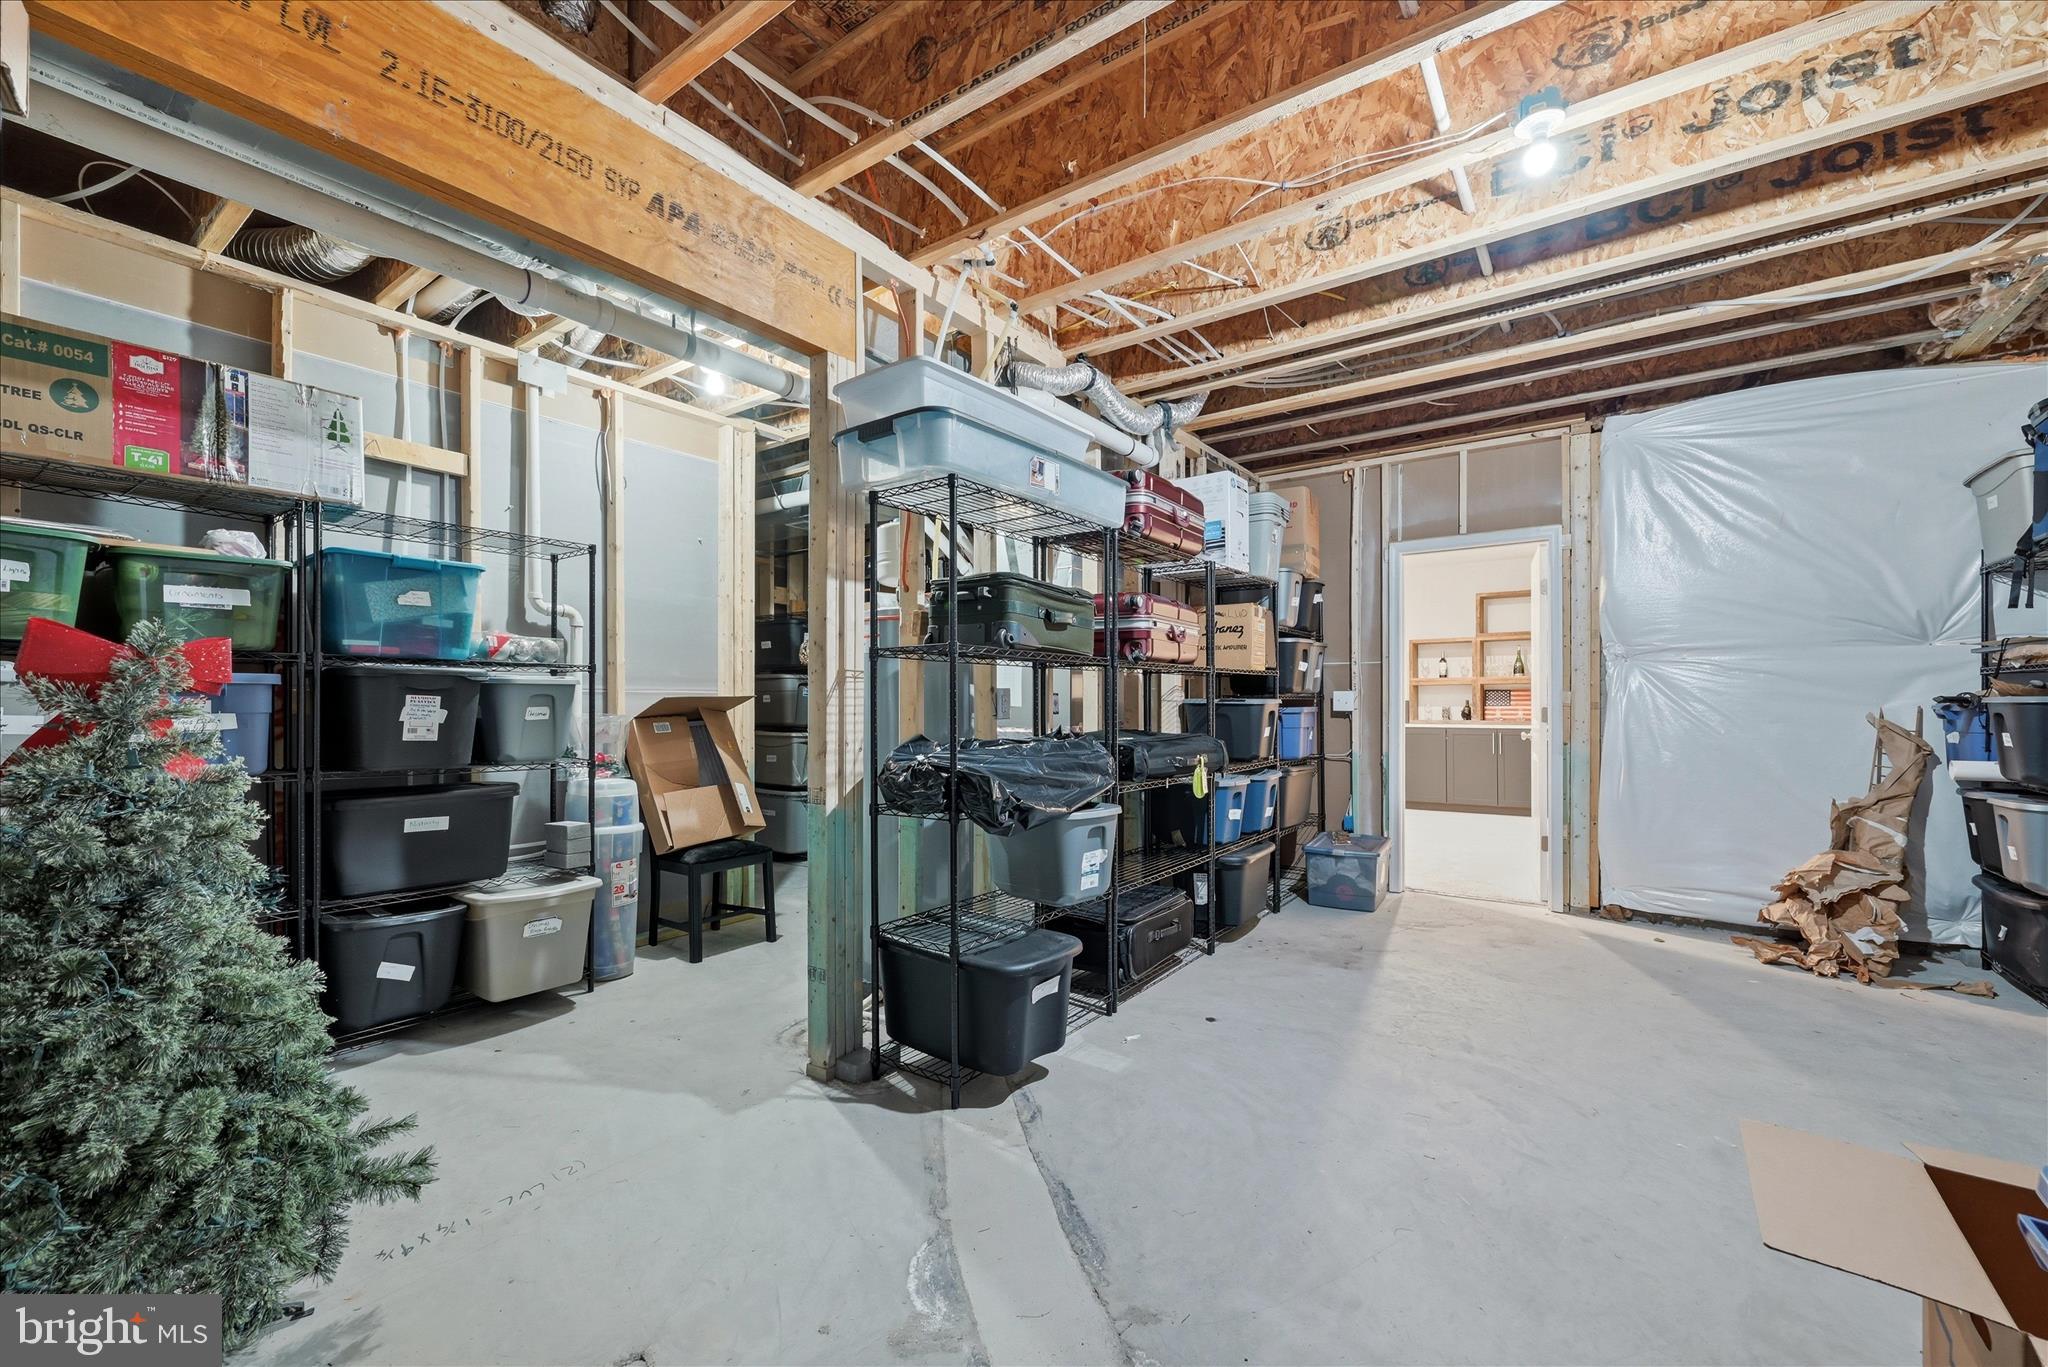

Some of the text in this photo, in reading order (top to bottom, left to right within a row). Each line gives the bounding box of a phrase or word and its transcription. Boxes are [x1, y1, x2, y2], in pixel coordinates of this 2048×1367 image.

[900, 93, 951, 128] BOISE
[1064, 0, 1132, 35] ROXBO
[1101, 39, 1141, 66] BOISE
[1680, 33, 1928, 136] Joist
[1769, 103, 1997, 189] Joist
[645, 191, 704, 238] APA
[1784, 225, 1847, 247] 6000S
[1938, 184, 2012, 209] JOIST
[1, 333, 95, 364] Cat.# 0054
[28, 423, 84, 442] QS-CLR
[131, 452, 163, 466] T-41
[1201, 620, 1245, 639] anez
